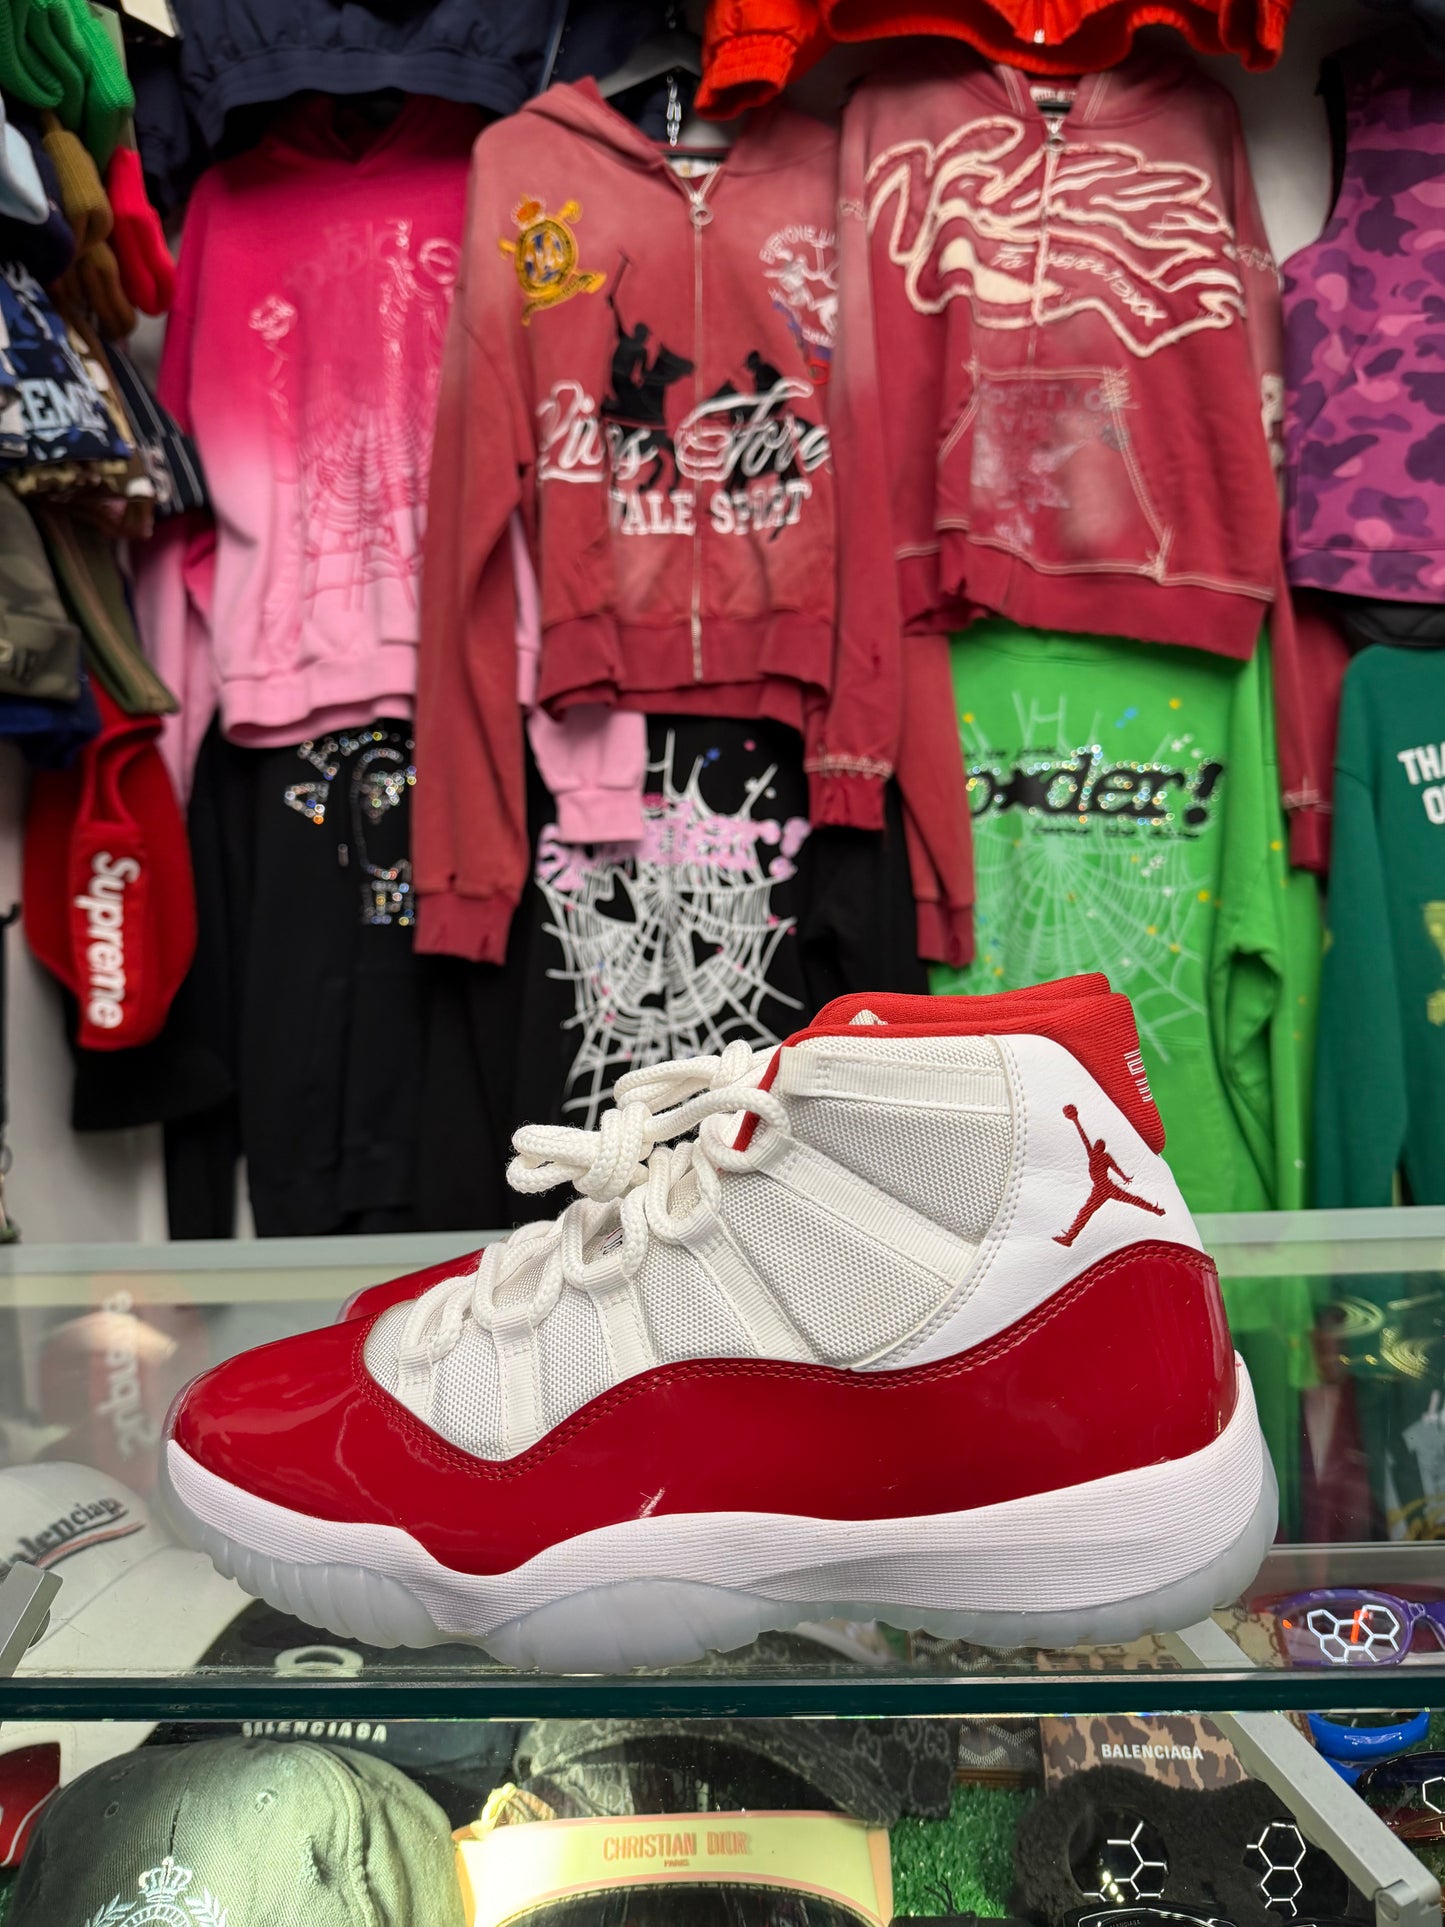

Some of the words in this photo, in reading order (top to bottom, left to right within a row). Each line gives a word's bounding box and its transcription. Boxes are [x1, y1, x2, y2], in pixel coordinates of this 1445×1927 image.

[74, 851, 141, 1030] Supreme
[1101, 1743, 1205, 1760] BALENCIAGA
[603, 1832, 698, 1862] CHRISTIAN
